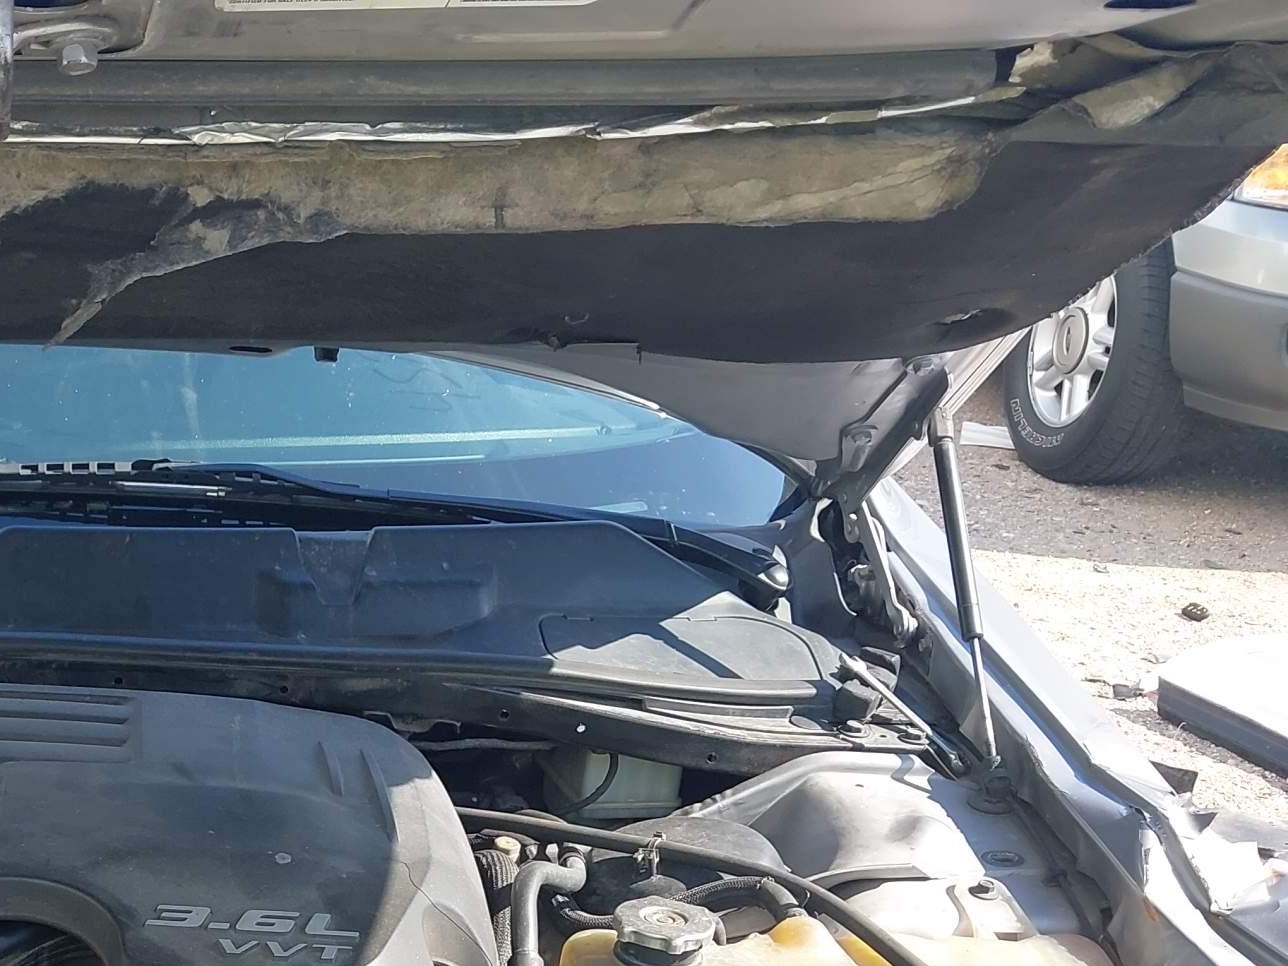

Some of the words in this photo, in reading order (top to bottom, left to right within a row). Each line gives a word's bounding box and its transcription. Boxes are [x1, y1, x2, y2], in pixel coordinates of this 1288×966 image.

[1009, 397, 1065, 448] MICHELIN
[144, 904, 360, 938] 3.6L
[218, 937, 353, 961] VVT
